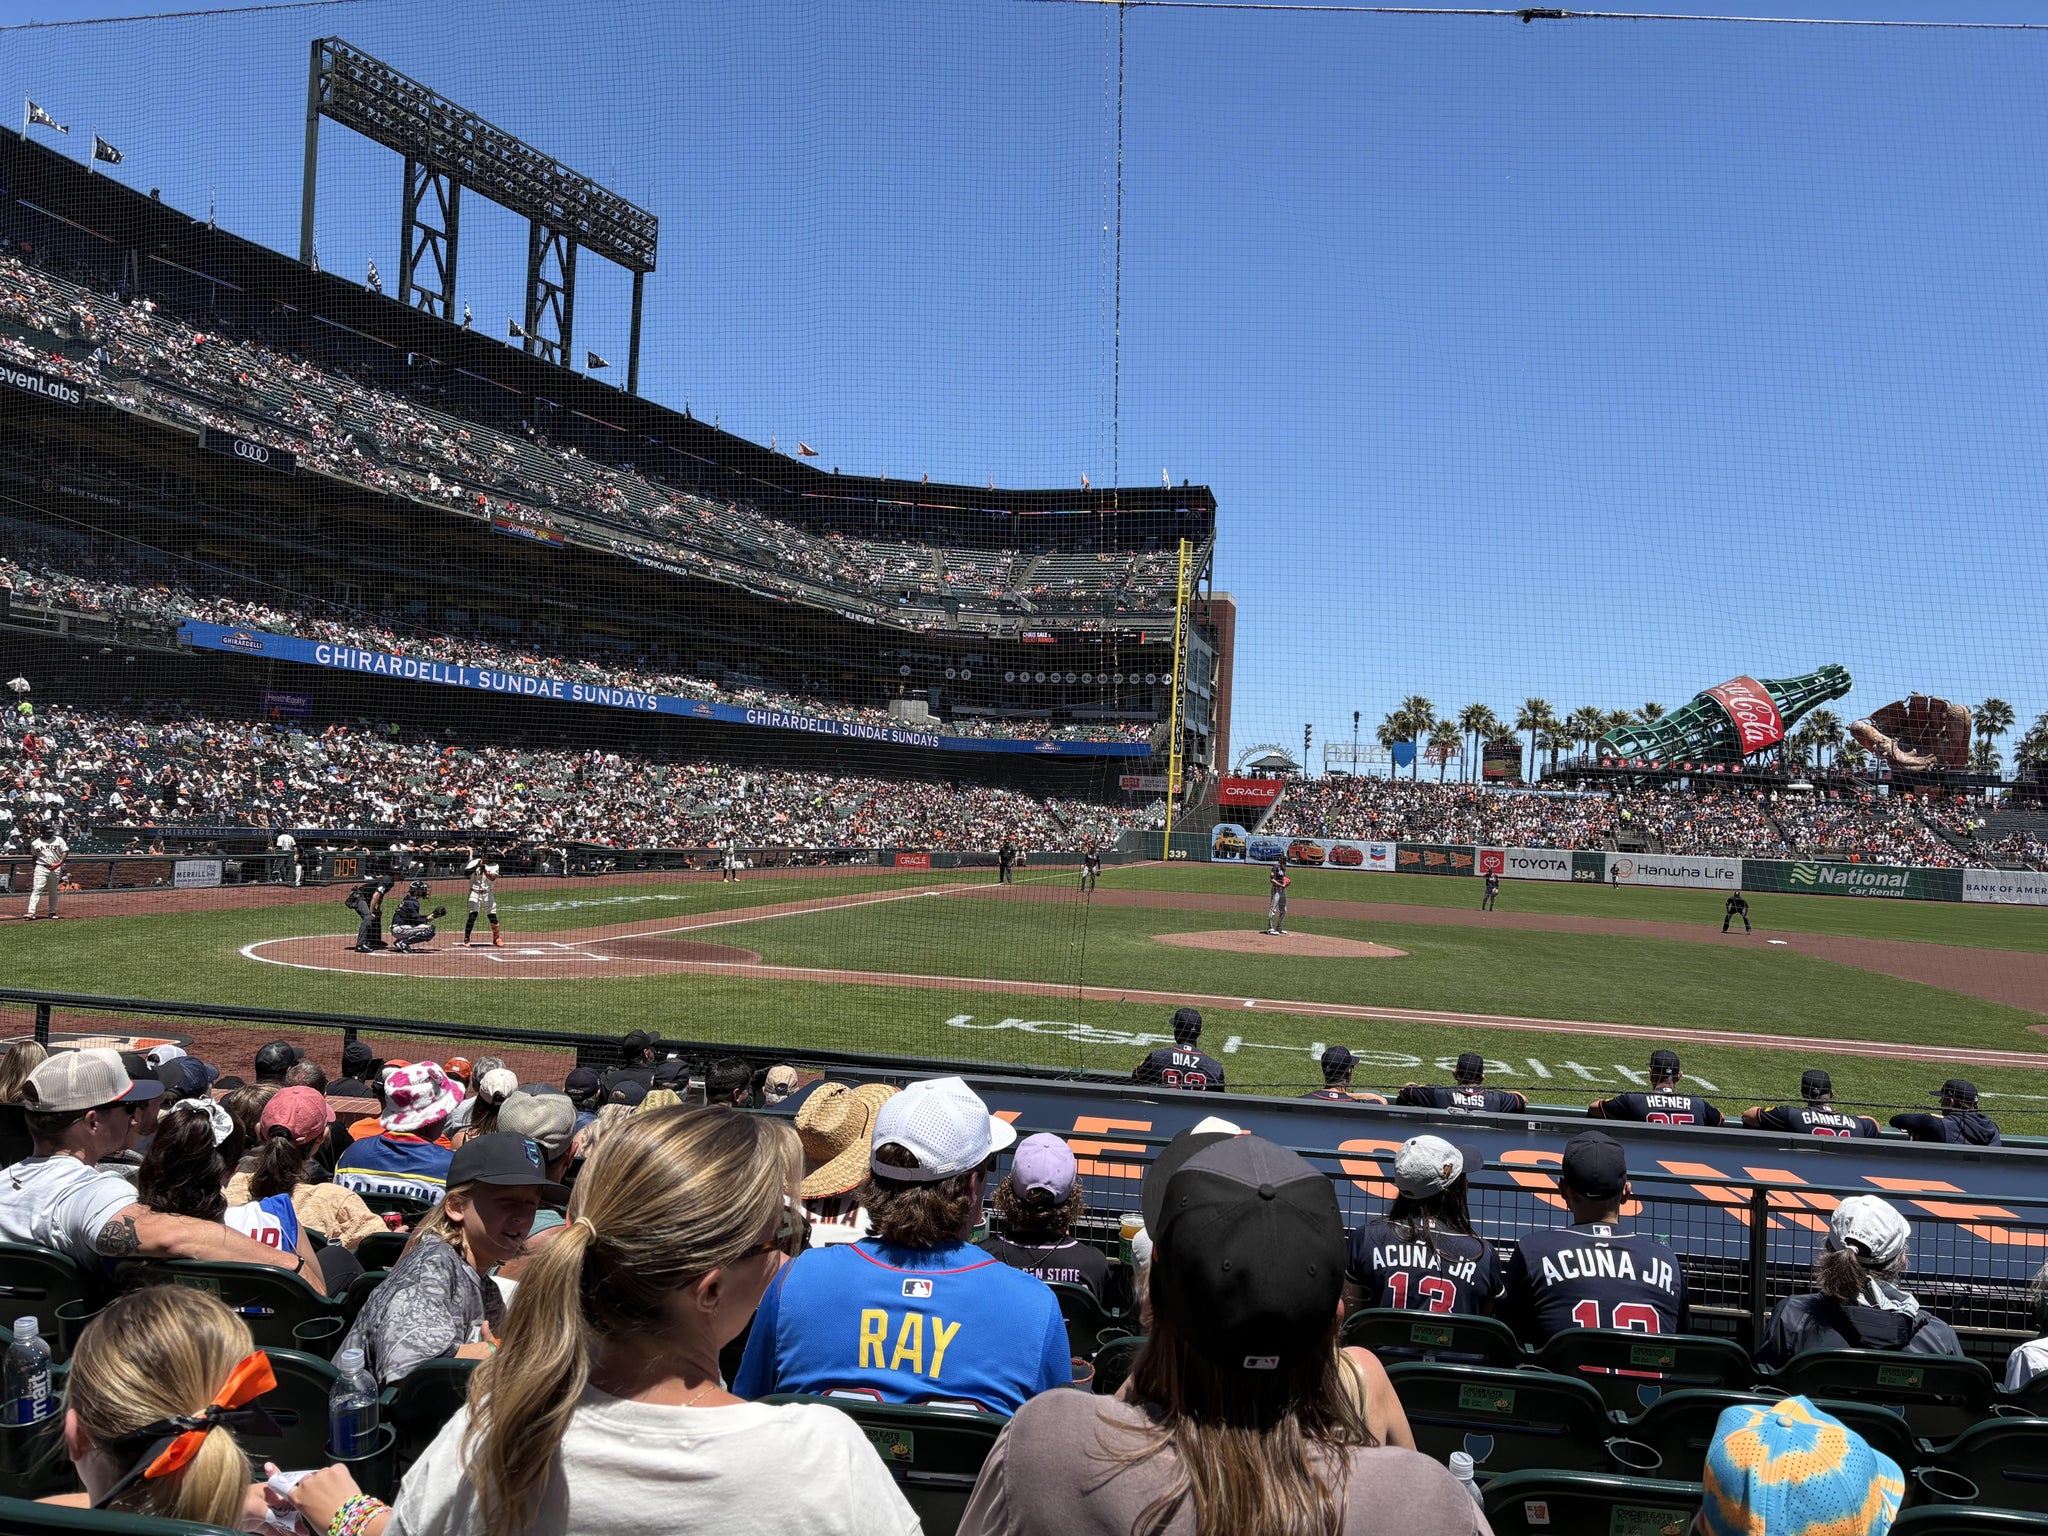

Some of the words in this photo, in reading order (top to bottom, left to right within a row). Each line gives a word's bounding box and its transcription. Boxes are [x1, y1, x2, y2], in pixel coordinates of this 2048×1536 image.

[223, 637, 262, 649] GHIRARDELLI
[479, 672, 564, 699] SUNDAE
[573, 685, 657, 710] SUNDAYS
[842, 723, 888, 740] SUNDAE
[892, 730, 939, 747] SUNDAYS
[1225, 787, 1275, 797] ORACLE
[1169, 850, 1188, 859] 339
[1510, 858, 1567, 870] TOYOTA
[1637, 864, 1700, 878] Hanwha
[1704, 867, 1735, 880] Life
[1575, 870, 1596, 880] 354
[1818, 867, 1909, 888] National
[1849, 886, 1867, 895] Car
[1869, 887, 1904, 897] Rental
[1966, 884, 1996, 893] BANK
[1999, 885, 2013, 894] OF
[1172, 1052, 1200, 1069] DIAZ
[1452, 1093, 1485, 1108] WEISS
[1646, 1096, 1691, 1111] HEFNER
[1802, 1111, 1857, 1130] GARNEAU
[1372, 1241, 1442, 1272] ACUÑA
[1047, 1268, 1080, 1282] STATE
[1541, 1243, 1637, 1287] ACUÑA
[1642, 1259, 1676, 1296] JR.
[1388, 1271, 1456, 1314] 13
[858, 1308, 962, 1379] RAY
[28, 1370, 47, 1422] mart
